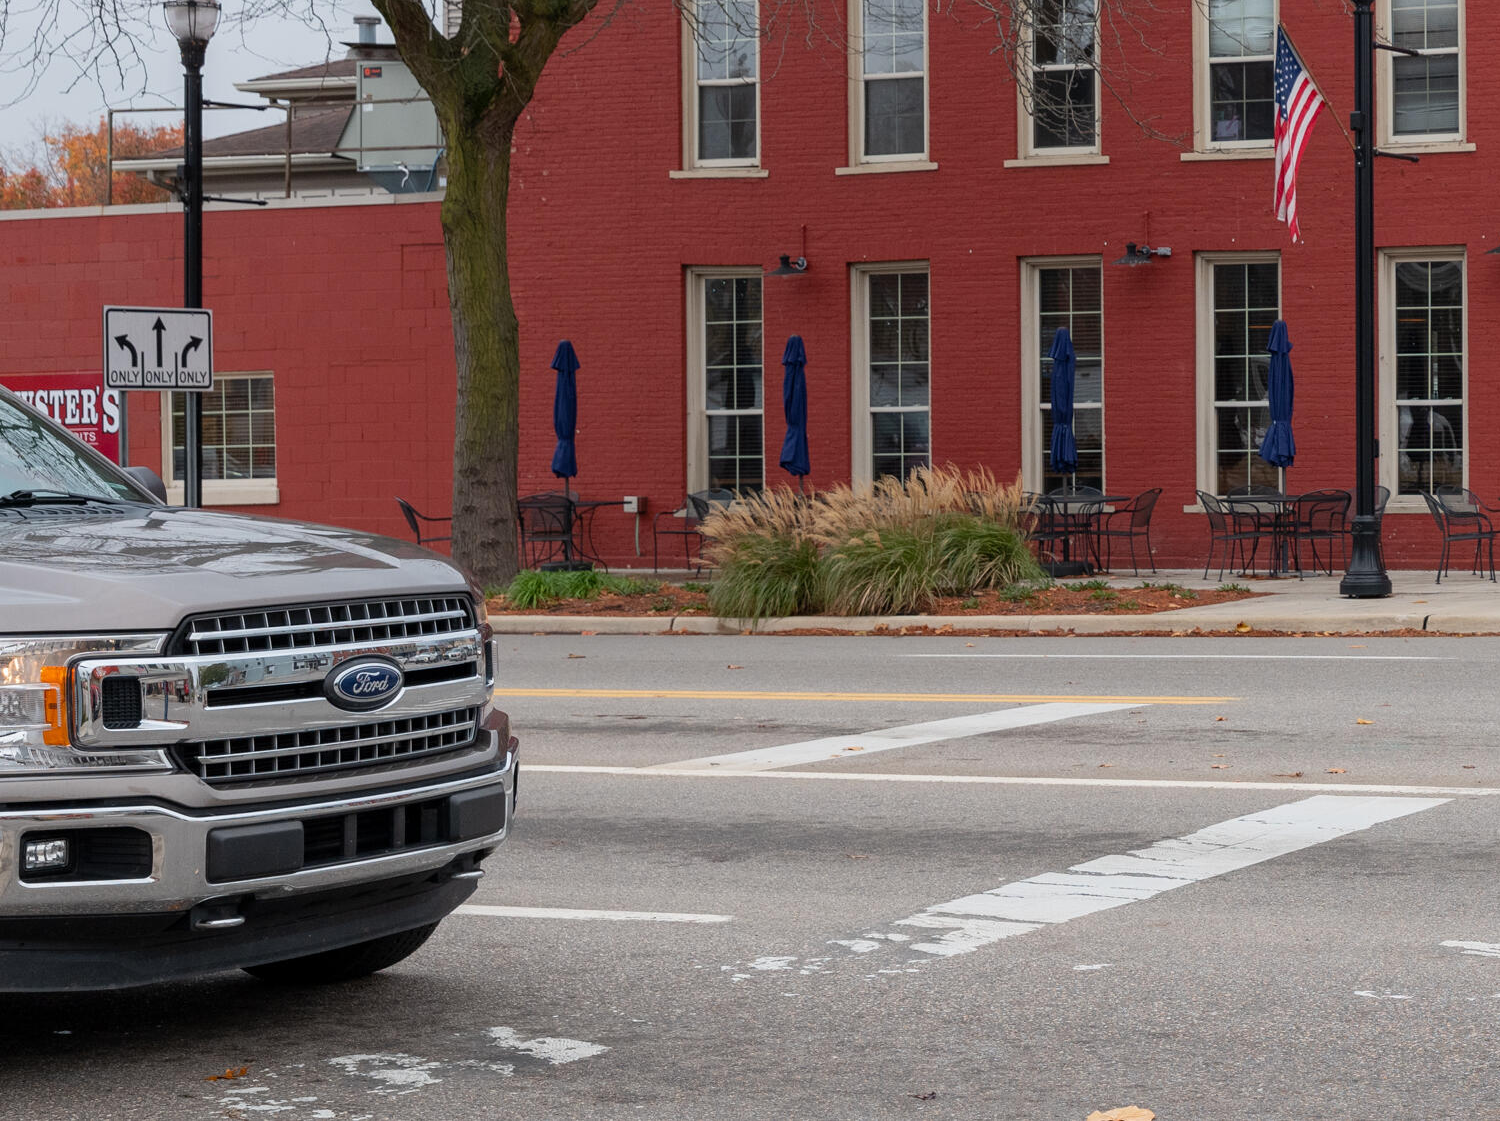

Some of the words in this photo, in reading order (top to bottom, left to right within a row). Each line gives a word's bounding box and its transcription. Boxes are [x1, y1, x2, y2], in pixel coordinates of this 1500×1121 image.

[111, 370, 140, 383] ONLY
[145, 370, 174, 384] ONLY
[180, 370, 207, 384] ONLY
[353, 671, 390, 694] Ford
